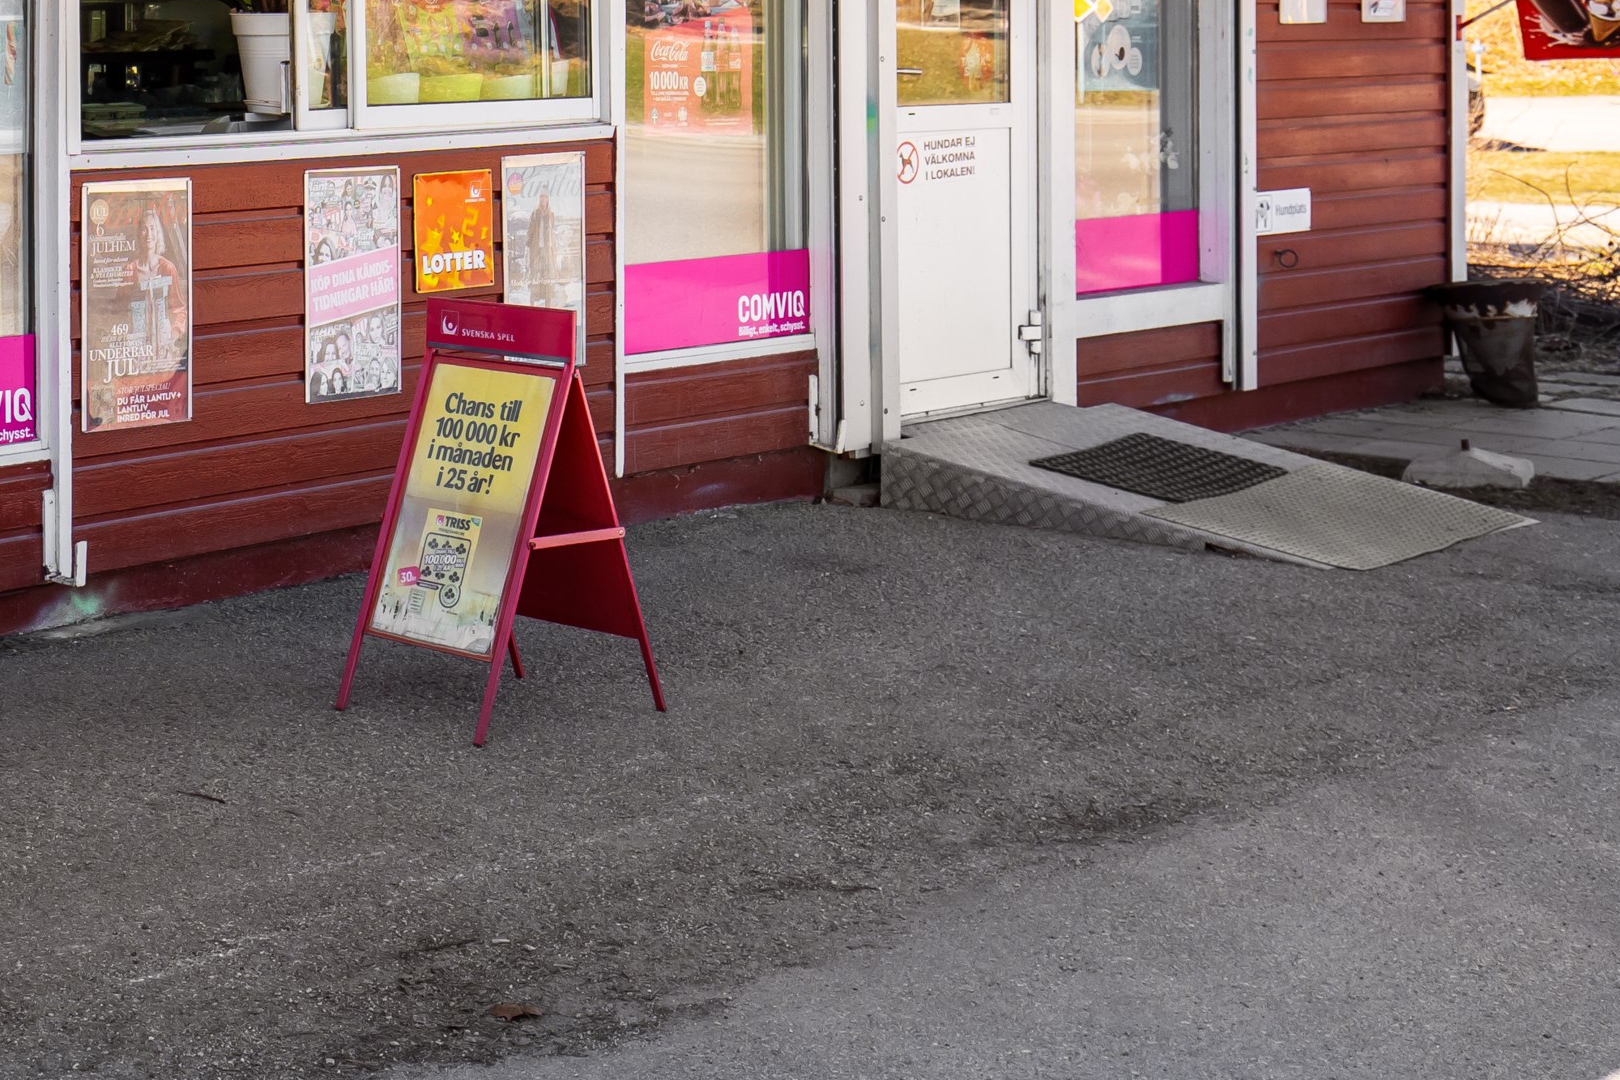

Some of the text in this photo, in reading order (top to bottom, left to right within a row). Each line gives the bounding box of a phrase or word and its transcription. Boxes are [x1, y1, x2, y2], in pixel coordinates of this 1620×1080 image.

[649, 71, 689, 90] 10 000 KR
[923, 136, 976, 151] HUNDAR EJ
[924, 151, 976, 166] VÄLKOMNA
[925, 166, 976, 181] I LOKALEN!
[93, 208, 108, 219] JUL
[1275, 204, 1308, 217] Hundplats
[96, 222, 105, 237] 6
[90, 240, 136, 257] JULHEM
[422, 250, 487, 275] LOTTER
[311, 260, 393, 293] KÖP DINA KÄNDIS-
[313, 277, 395, 312] TIDNINGAR HÄR!
[738, 290, 806, 323] COMVIQ
[111, 324, 129, 336] 469
[461, 328, 515, 342] SVENSKA SPEL
[89, 345, 154, 361] UNDERBAR
[103, 358, 140, 384] JUL
[117, 397, 129, 405] DU
[130, 394, 145, 404] FÅR
[444, 392, 523, 423] Chans till
[117, 404, 149, 414] LANTLIV
[117, 409, 170, 422] INRED FÖR JUL
[435, 417, 521, 449] 100 000 kr
[427, 439, 514, 472] i månaden
[435, 466, 495, 496] i 25 år!
[445, 515, 471, 531] TRISS
